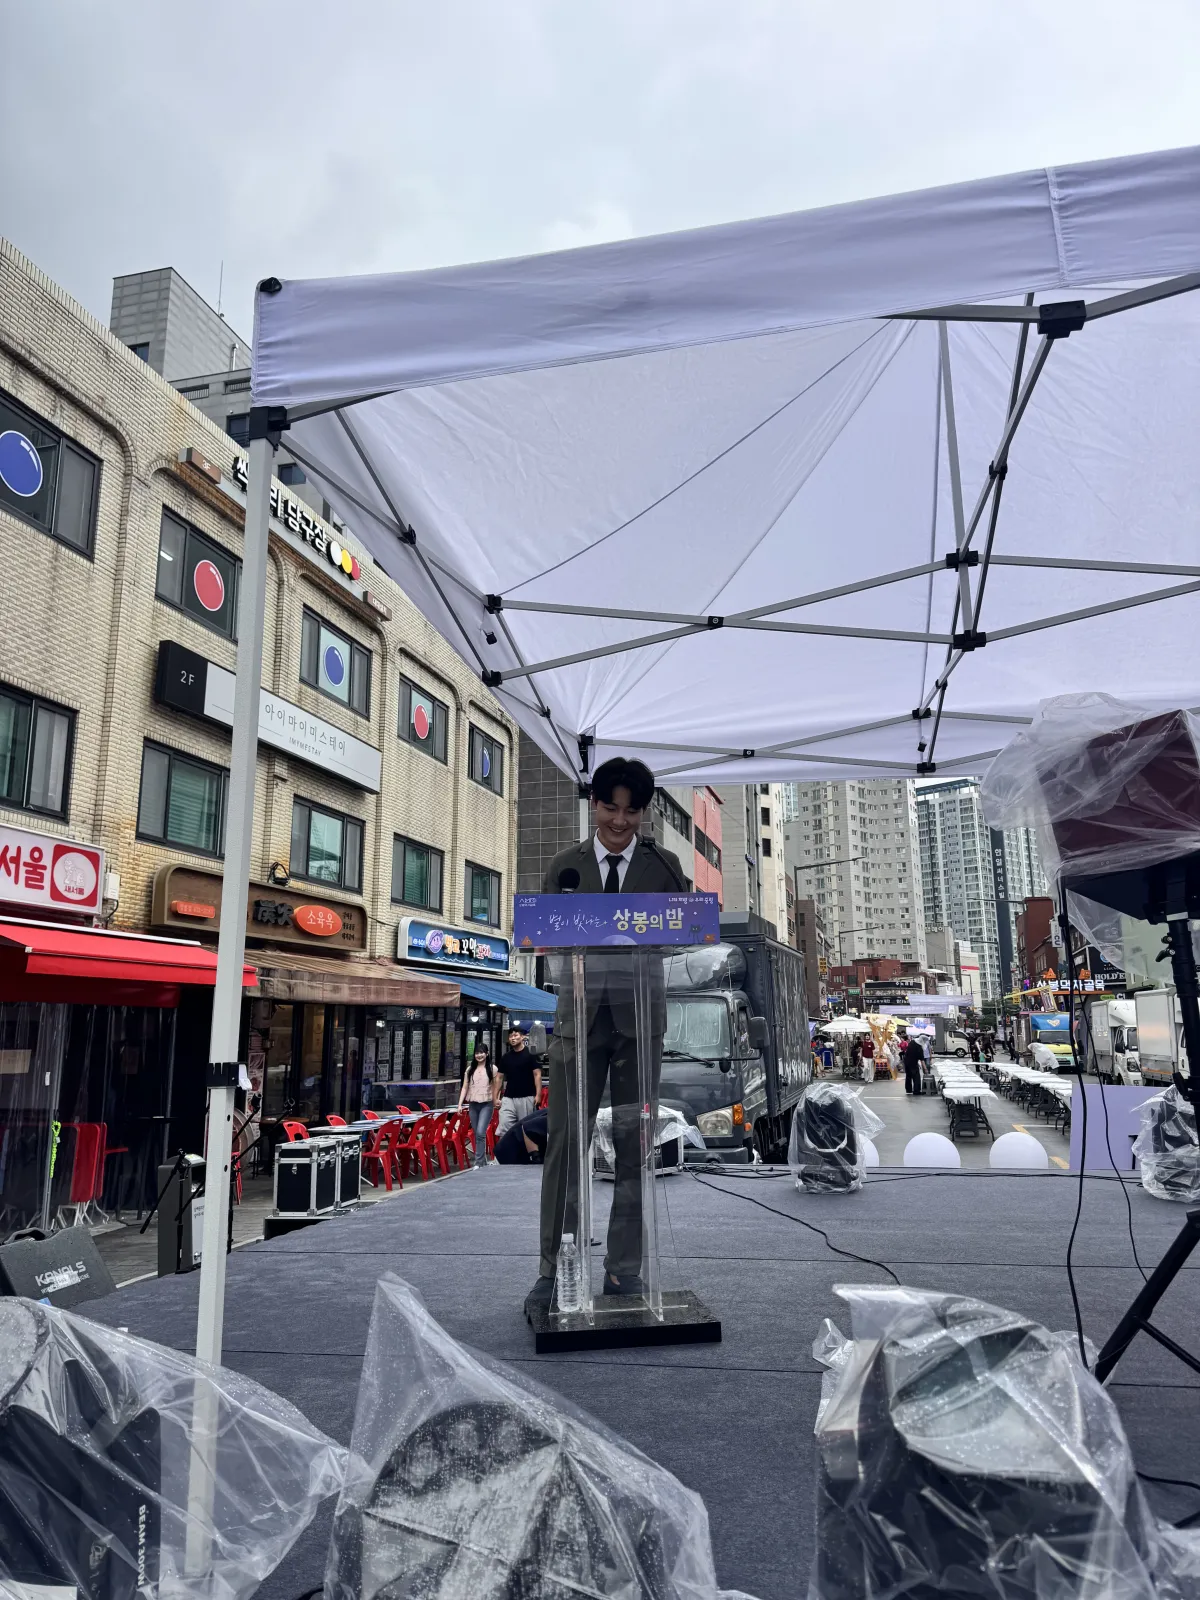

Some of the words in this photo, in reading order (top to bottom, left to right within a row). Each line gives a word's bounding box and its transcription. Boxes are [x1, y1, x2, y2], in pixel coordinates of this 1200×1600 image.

[286, 499, 327, 552] 당구장
[180, 670, 195, 686] 2F
[264, 703, 346, 756] 아이마이미스테이
[289, 736, 322, 757] IMYMESTAY
[549, 913, 569, 932] 별이
[573, 913, 605, 935] 빛나는
[612, 908, 663, 934] 상봉의
[665, 907, 685, 930] 밤
[1094, 972, 1126, 980] HOLD'E
[138, 1504, 147, 1546] BEAM
[137, 1546, 146, 1586] 300W
